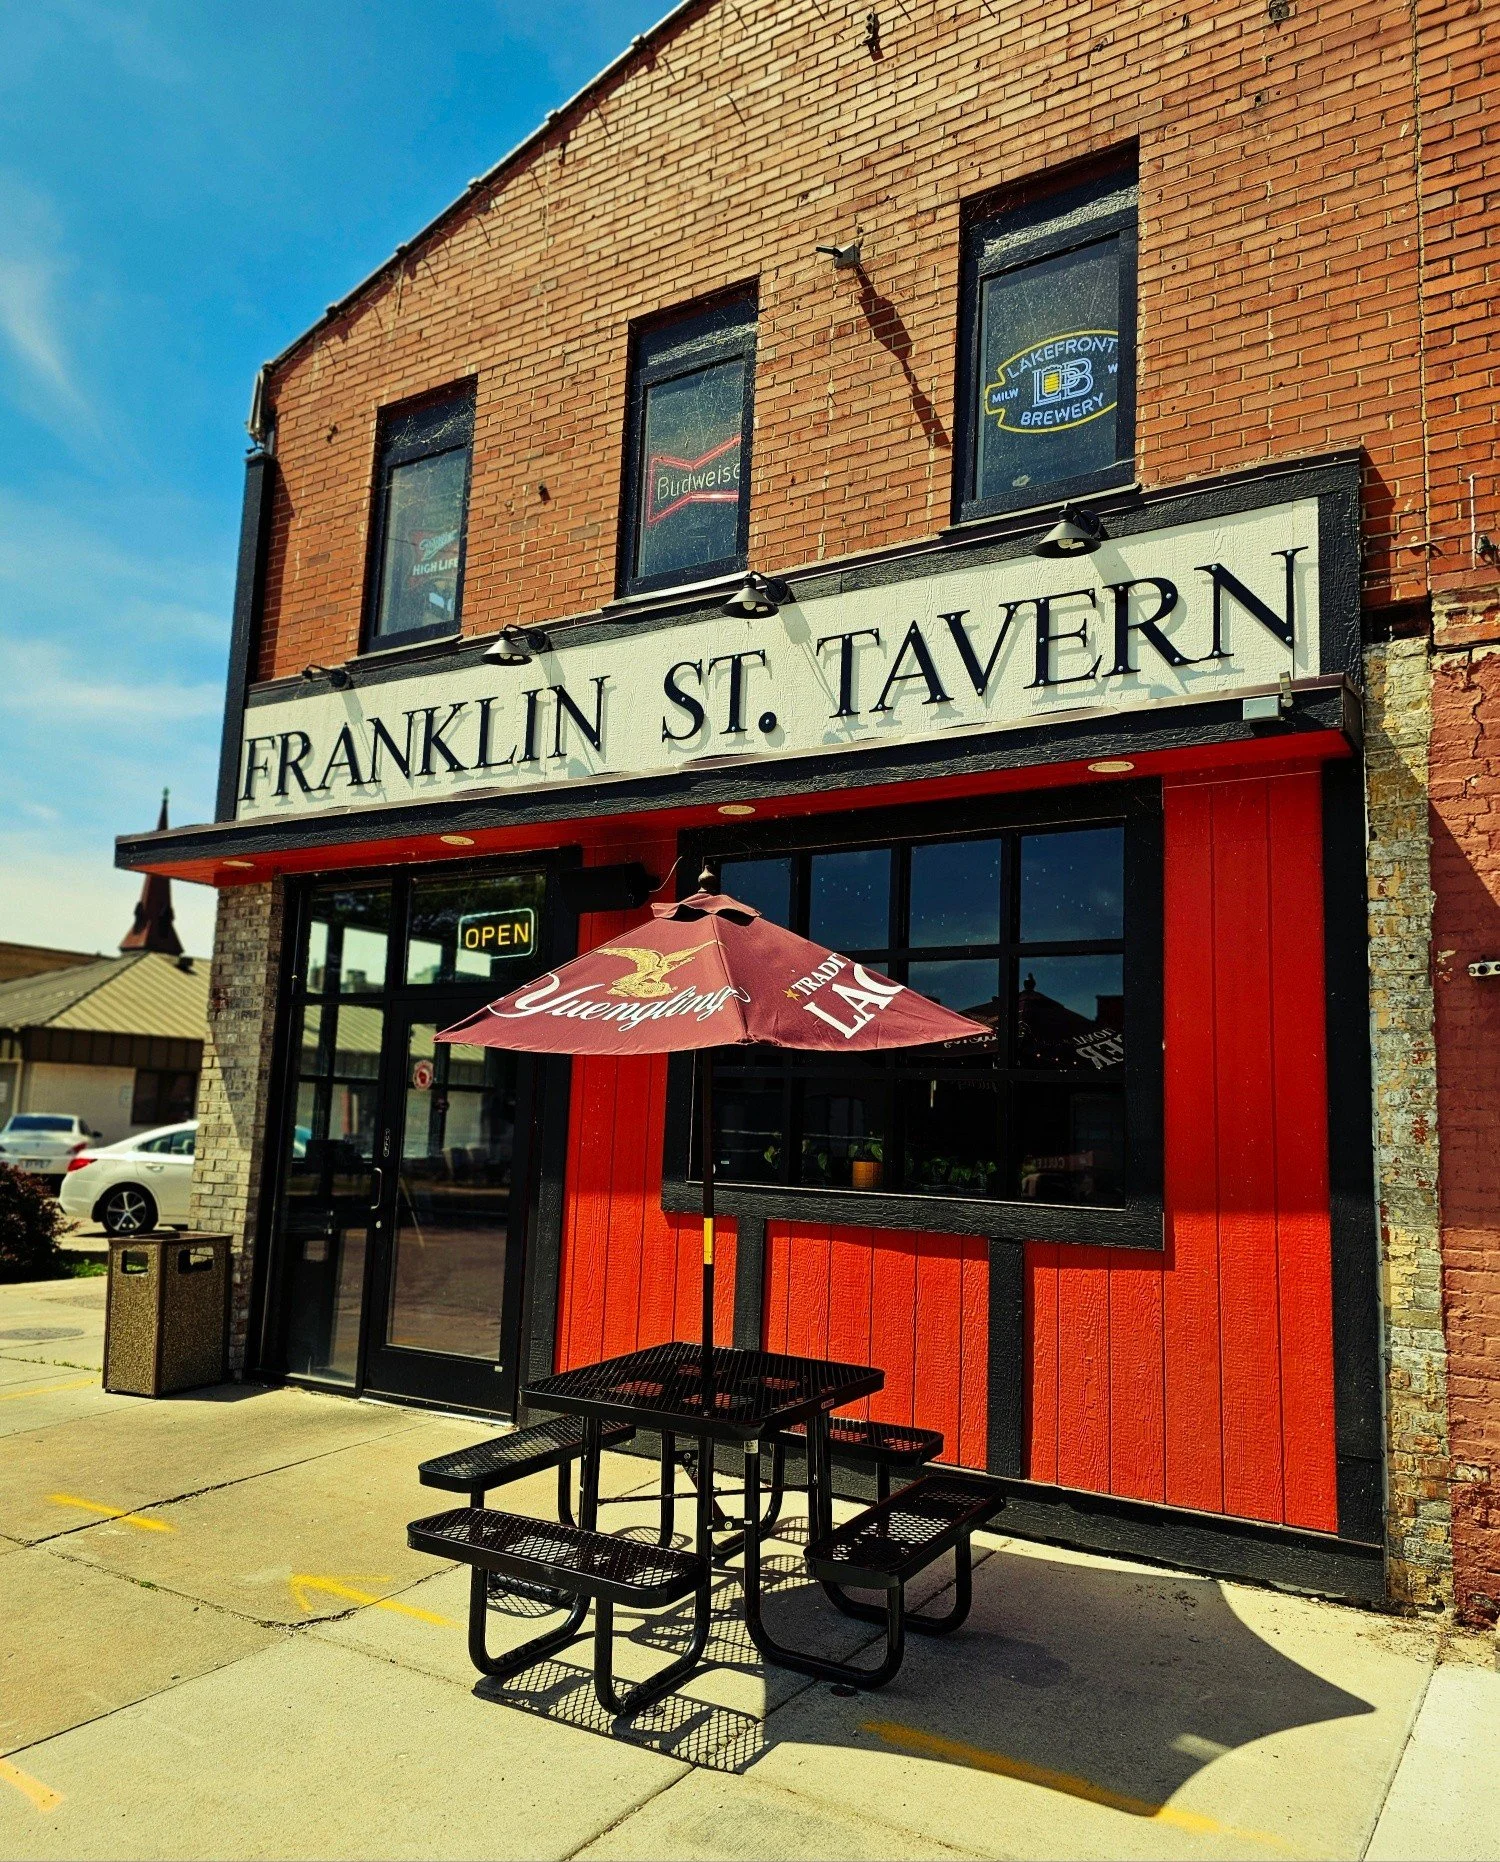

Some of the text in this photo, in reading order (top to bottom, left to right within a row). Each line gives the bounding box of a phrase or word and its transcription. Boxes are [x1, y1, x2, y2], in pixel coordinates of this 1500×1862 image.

[1006, 337, 1119, 379] LAKEFRONT
[990, 388, 1019, 403] MILW
[1020, 392, 1104, 426] BREWERY
[412, 562, 437, 576] HIGH
[238, 545, 1309, 801] FRANKLIN ST. TAVERN
[465, 922, 529, 949] OPEN
[791, 952, 852, 996] TRADI
